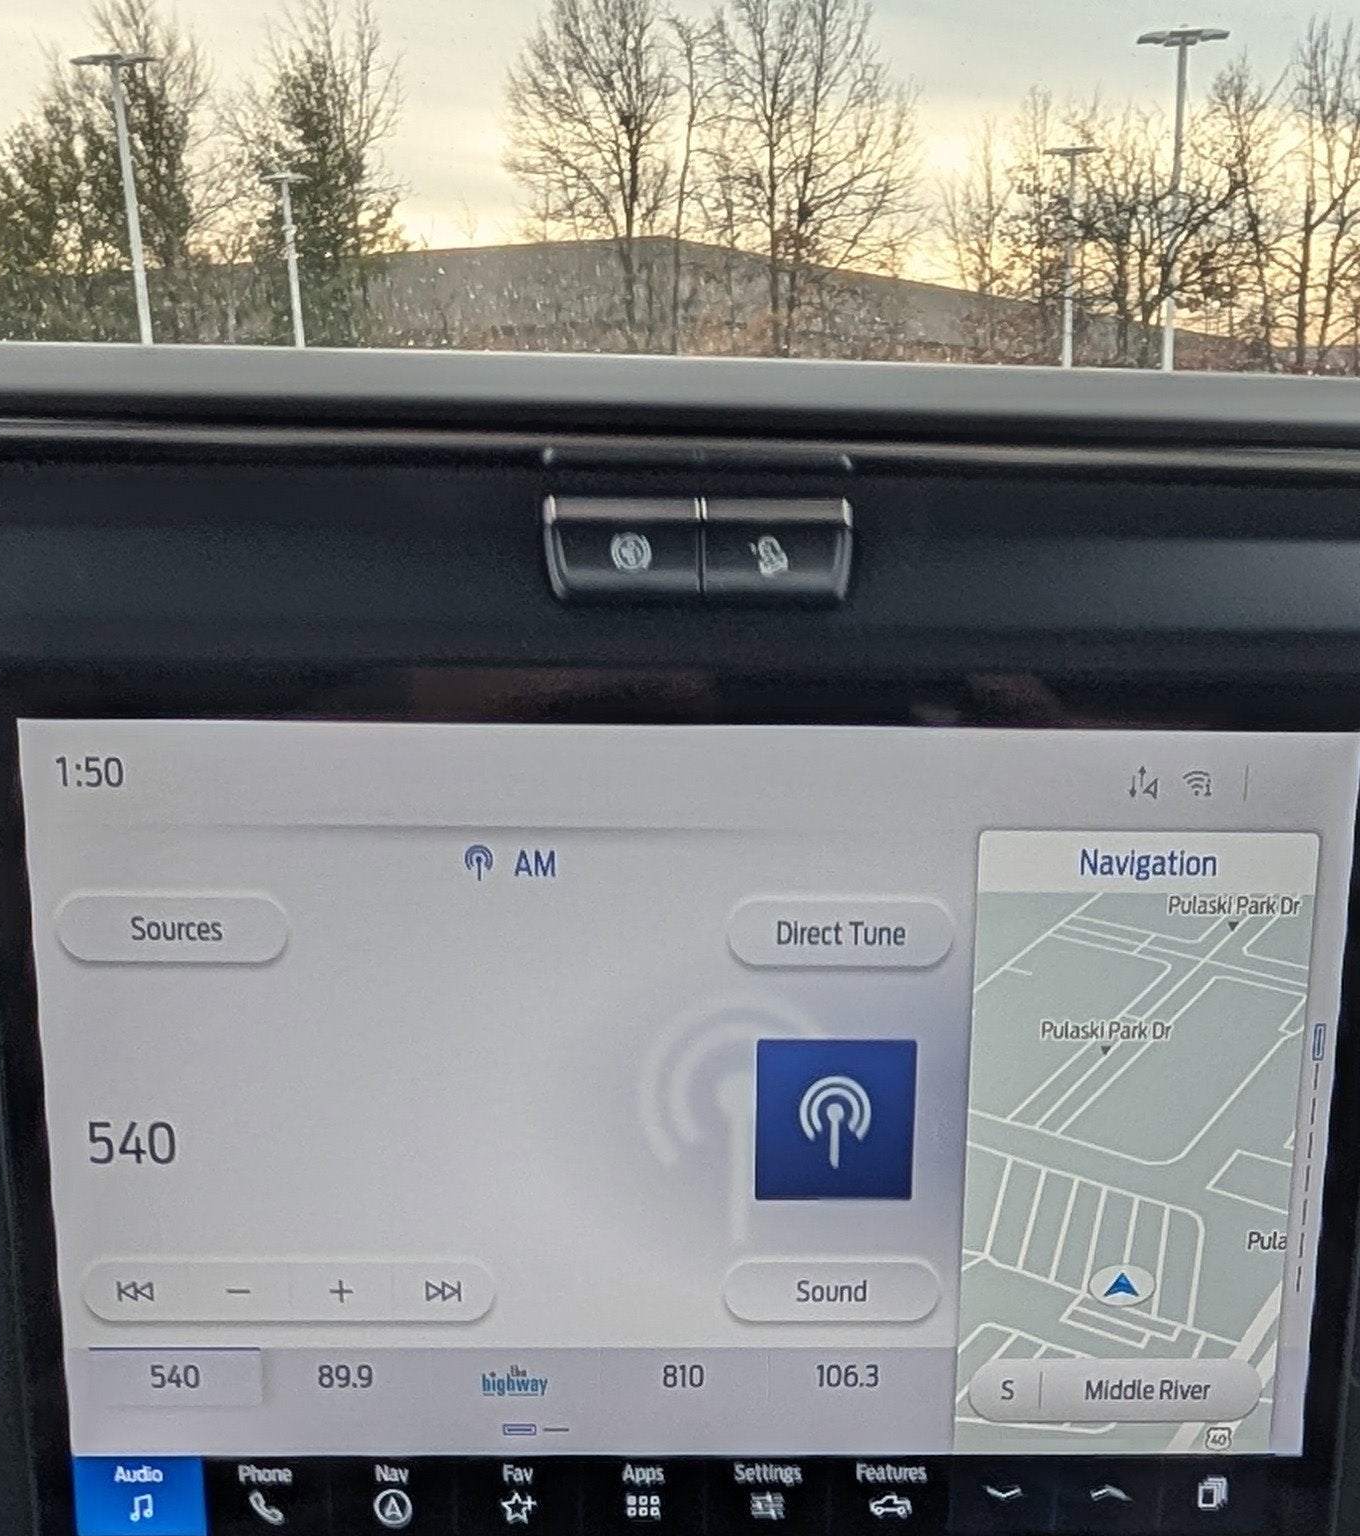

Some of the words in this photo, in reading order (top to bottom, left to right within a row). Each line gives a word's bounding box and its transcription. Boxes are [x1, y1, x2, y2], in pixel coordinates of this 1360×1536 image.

[54, 756, 125, 788] 1:50
[514, 850, 557, 878] AM
[1079, 849, 1218, 879] Navigation
[1168, 896, 1232, 915] Pulaski
[1237, 897, 1276, 915] Park
[1280, 897, 1300, 915] Dr
[131, 916, 223, 942] Sources
[776, 921, 842, 944] Direct
[848, 922, 906, 945] Tune
[1041, 1021, 1105, 1040] Pulaski
[1109, 1021, 1148, 1040] Park
[1152, 1021, 1172, 1040] Dr
[87, 1120, 177, 1165] 540
[1247, 1232, 1288, 1250] Pula
[796, 1280, 868, 1303] Sound
[150, 1365, 200, 1388] 540
[318, 1365, 373, 1388] 89.9
[481, 1371, 548, 1396] highway
[662, 1364, 705, 1388] 810
[816, 1365, 879, 1388] 106.3
[1001, 1380, 1015, 1400] S
[1085, 1380, 1155, 1401] Middle
[1159, 1380, 1210, 1401] River
[1211, 1434, 1226, 1446] 40
[115, 1466, 163, 1483] Audio
[238, 1465, 292, 1483] Phone
[375, 1465, 409, 1484] Nav
[503, 1465, 533, 1484] Fav
[623, 1465, 664, 1488] Apps
[734, 1465, 802, 1486] Settings
[856, 1464, 927, 1483] Features
